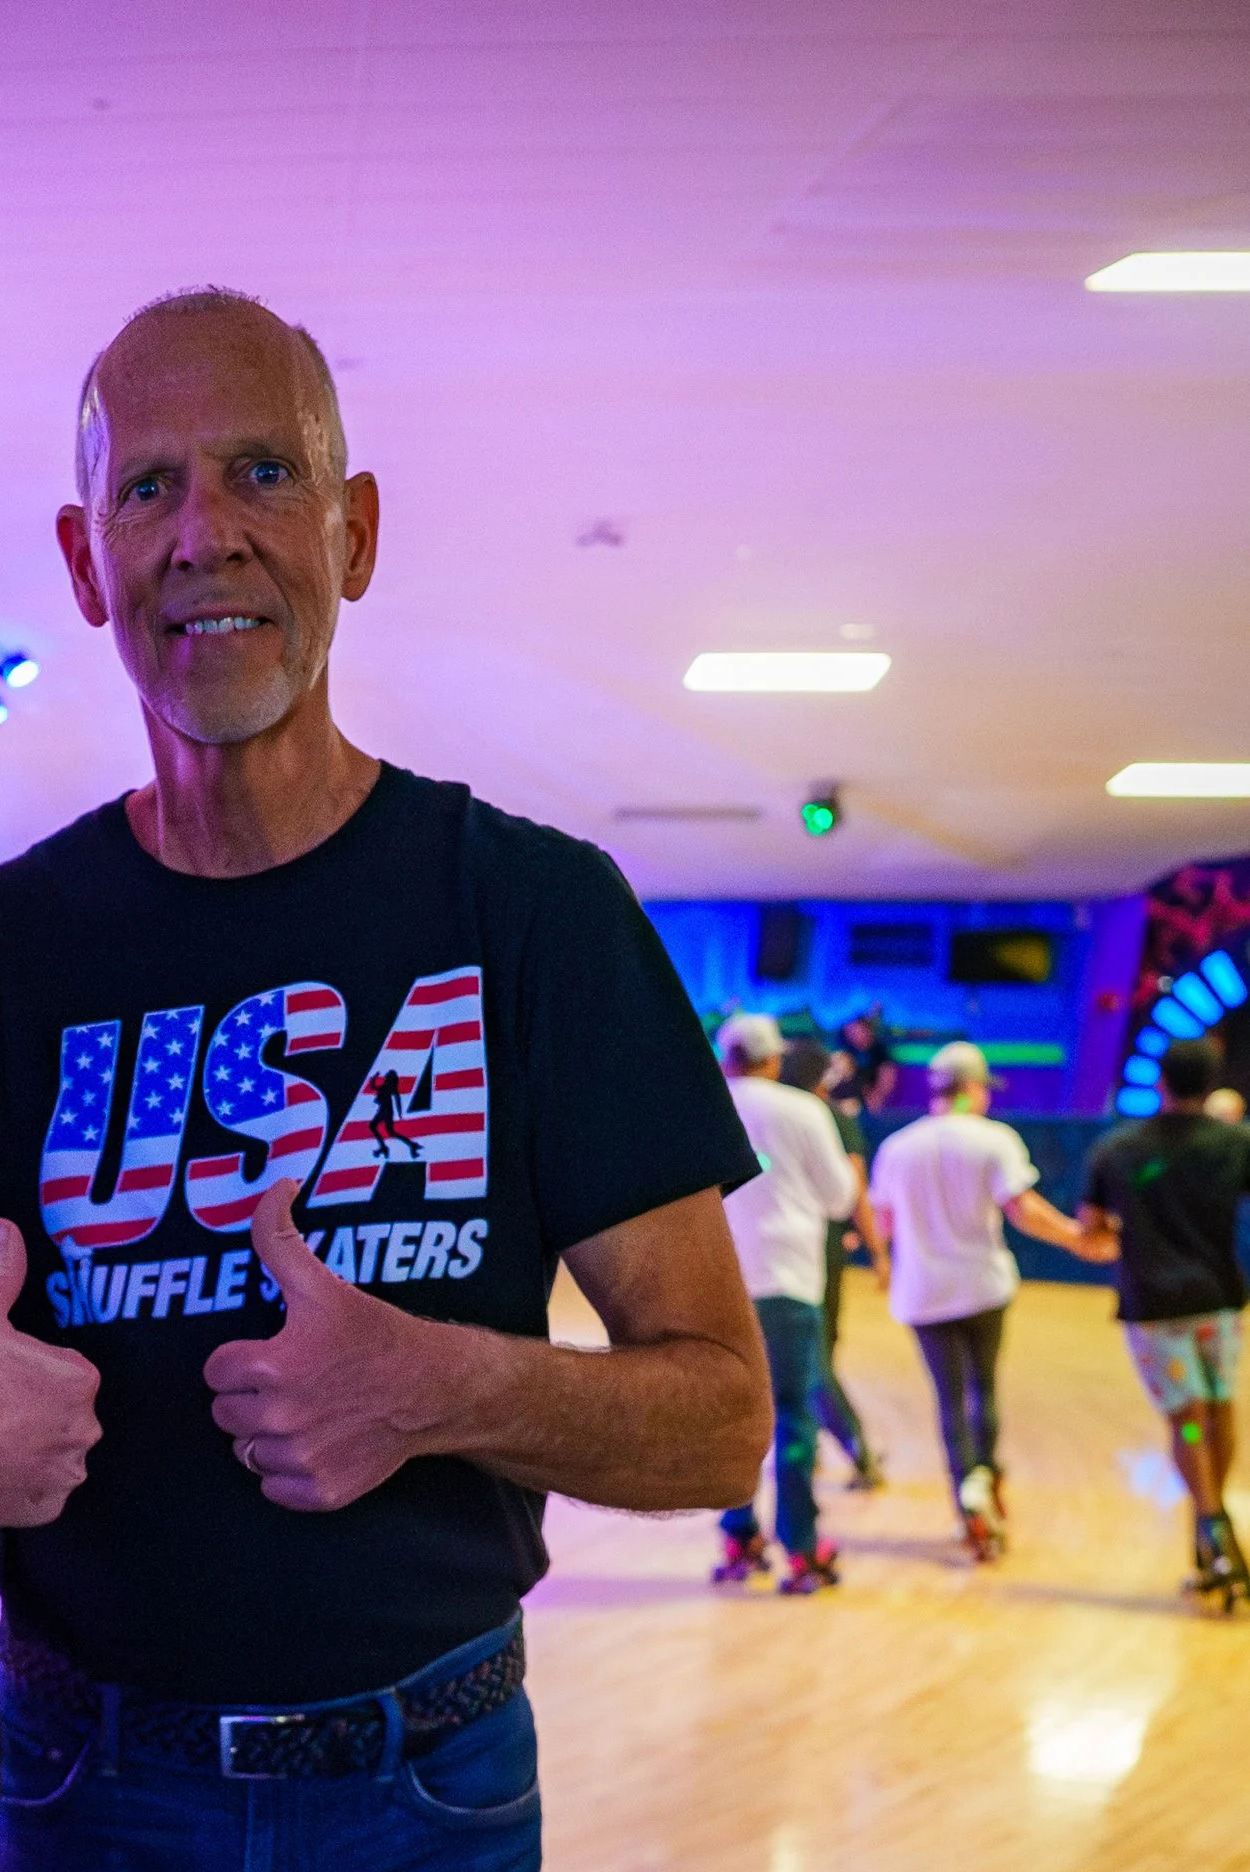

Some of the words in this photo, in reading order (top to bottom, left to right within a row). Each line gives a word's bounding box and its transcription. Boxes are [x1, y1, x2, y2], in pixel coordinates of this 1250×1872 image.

[40, 965, 488, 1250] USA
[45, 1249, 253, 1328] SHUFFLE
[259, 1218, 489, 1308] ATERS
